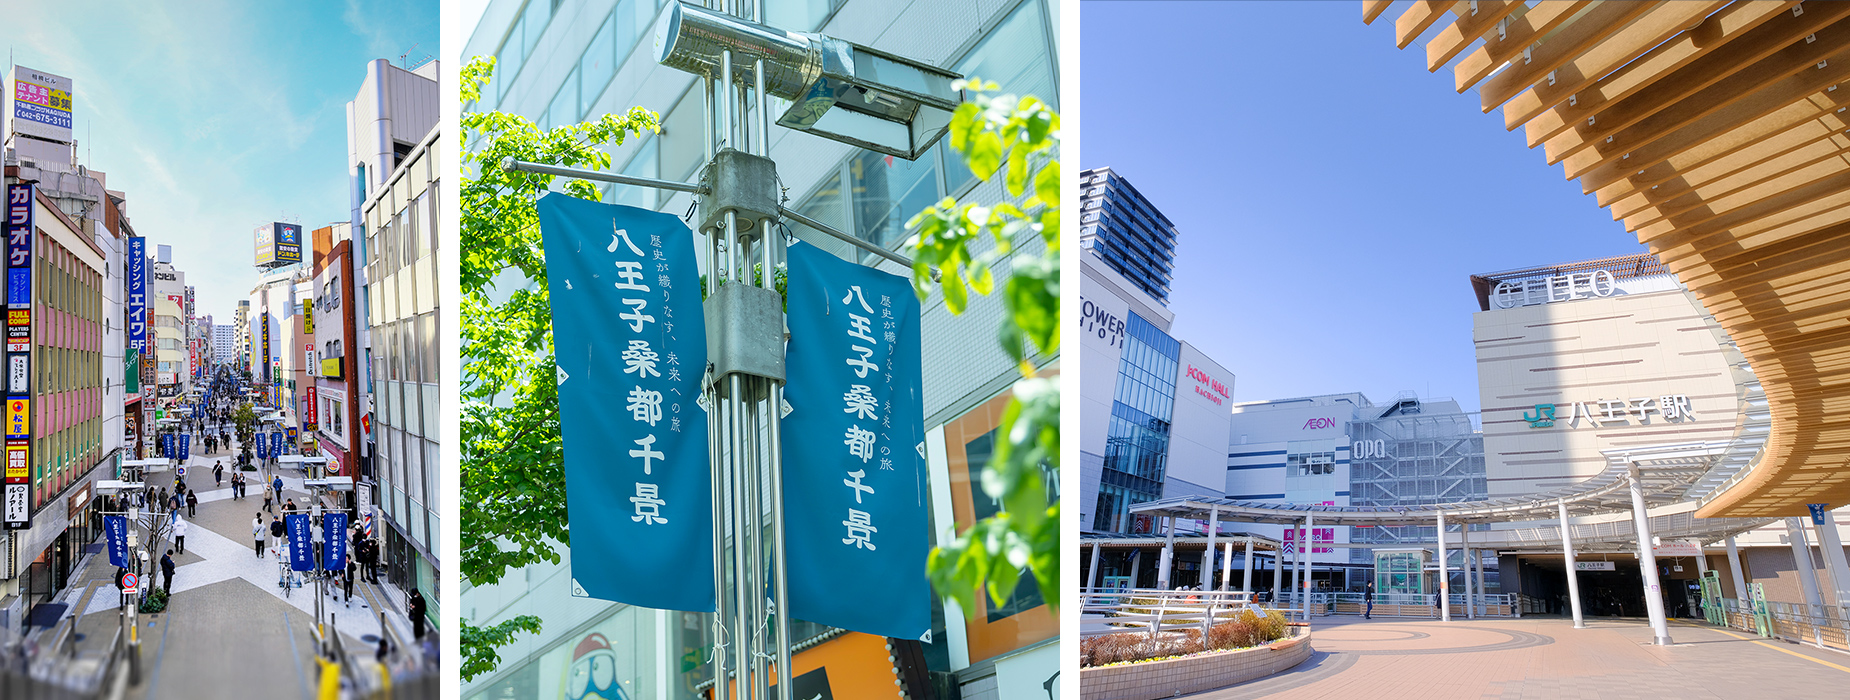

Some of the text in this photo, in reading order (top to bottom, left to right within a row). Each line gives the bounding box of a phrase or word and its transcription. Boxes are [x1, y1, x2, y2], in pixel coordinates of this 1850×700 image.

[17, 82, 48, 97] 広告主
[17, 91, 48, 104] テナント
[50, 95, 71, 110] 募集
[21, 110, 70, 128] 042-675-3111
[10, 186, 29, 266] カラオケ
[130, 241, 145, 350] キャッシング エイワ 5F
[9, 310, 29, 318] FULL
[607, 229, 668, 525] 八王子桑都千景
[1211, 378, 1231, 400] HALL
[842, 285, 879, 551] 八王子桑都千景
[1523, 393, 1693, 426] JR 八王子駅
[13, 414, 23, 433] 松屋
[1353, 438, 1387, 460] OPA
